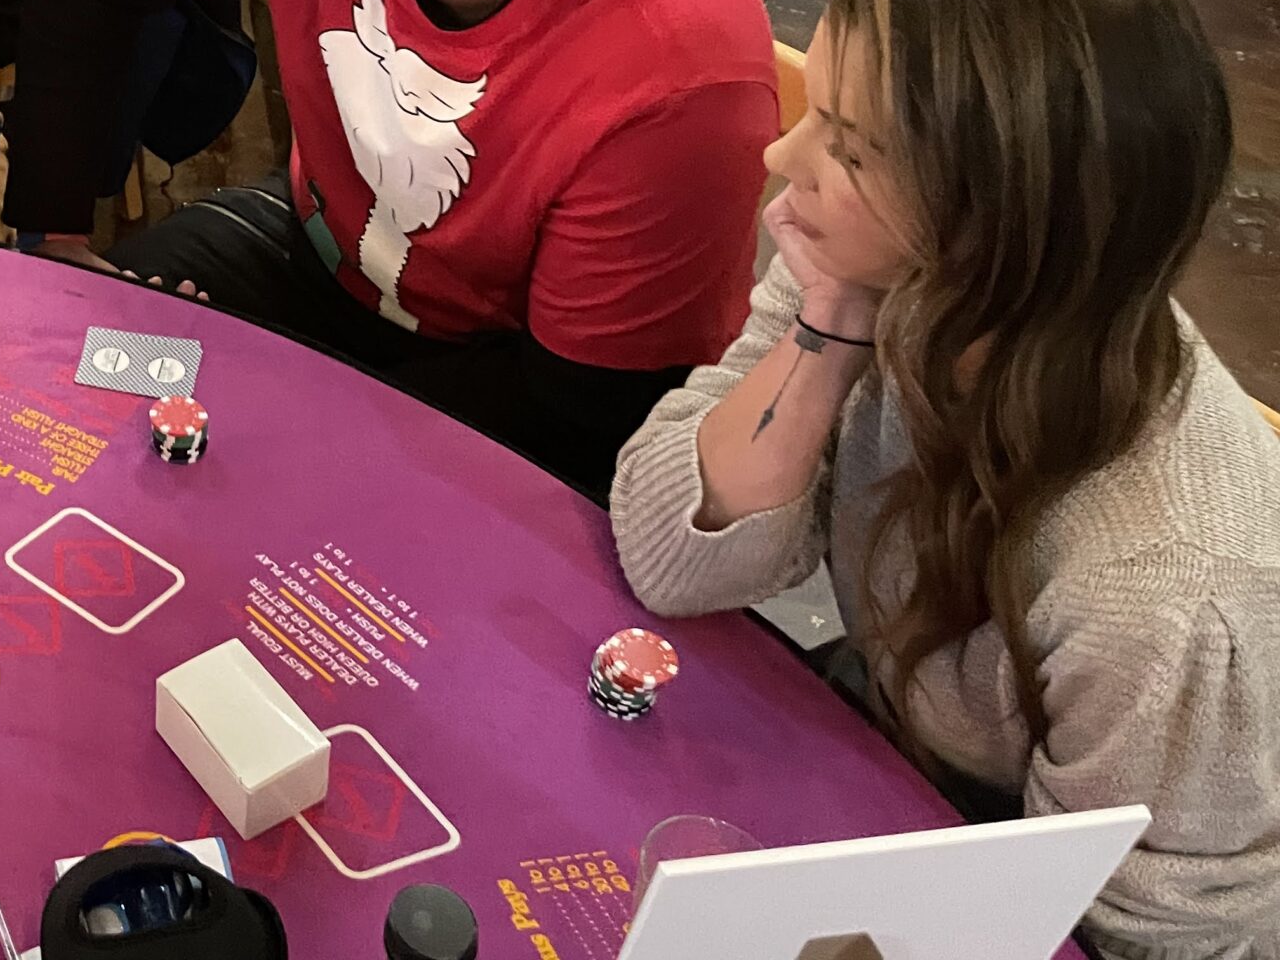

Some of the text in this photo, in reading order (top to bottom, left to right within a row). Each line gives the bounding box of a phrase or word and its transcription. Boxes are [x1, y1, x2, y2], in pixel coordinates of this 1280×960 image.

[39, 438, 94, 465] STRAIGHT
[55, 422, 108, 448] STRAIGHT
[14, 470, 54, 495] Pair
[255, 552, 418, 690] WHEN DEALER DOES NOT PLAY
[312, 552, 427, 648] WHEN DEALER PLAYS
[351, 612, 384, 640] PUSH
[246, 620, 313, 680] MUST EQUAL
[247, 591, 357, 685] DEALER PLAYS WITH
[249, 577, 378, 686] QUEEN HIGH OR BETTER
[497, 879, 539, 930] Pays
